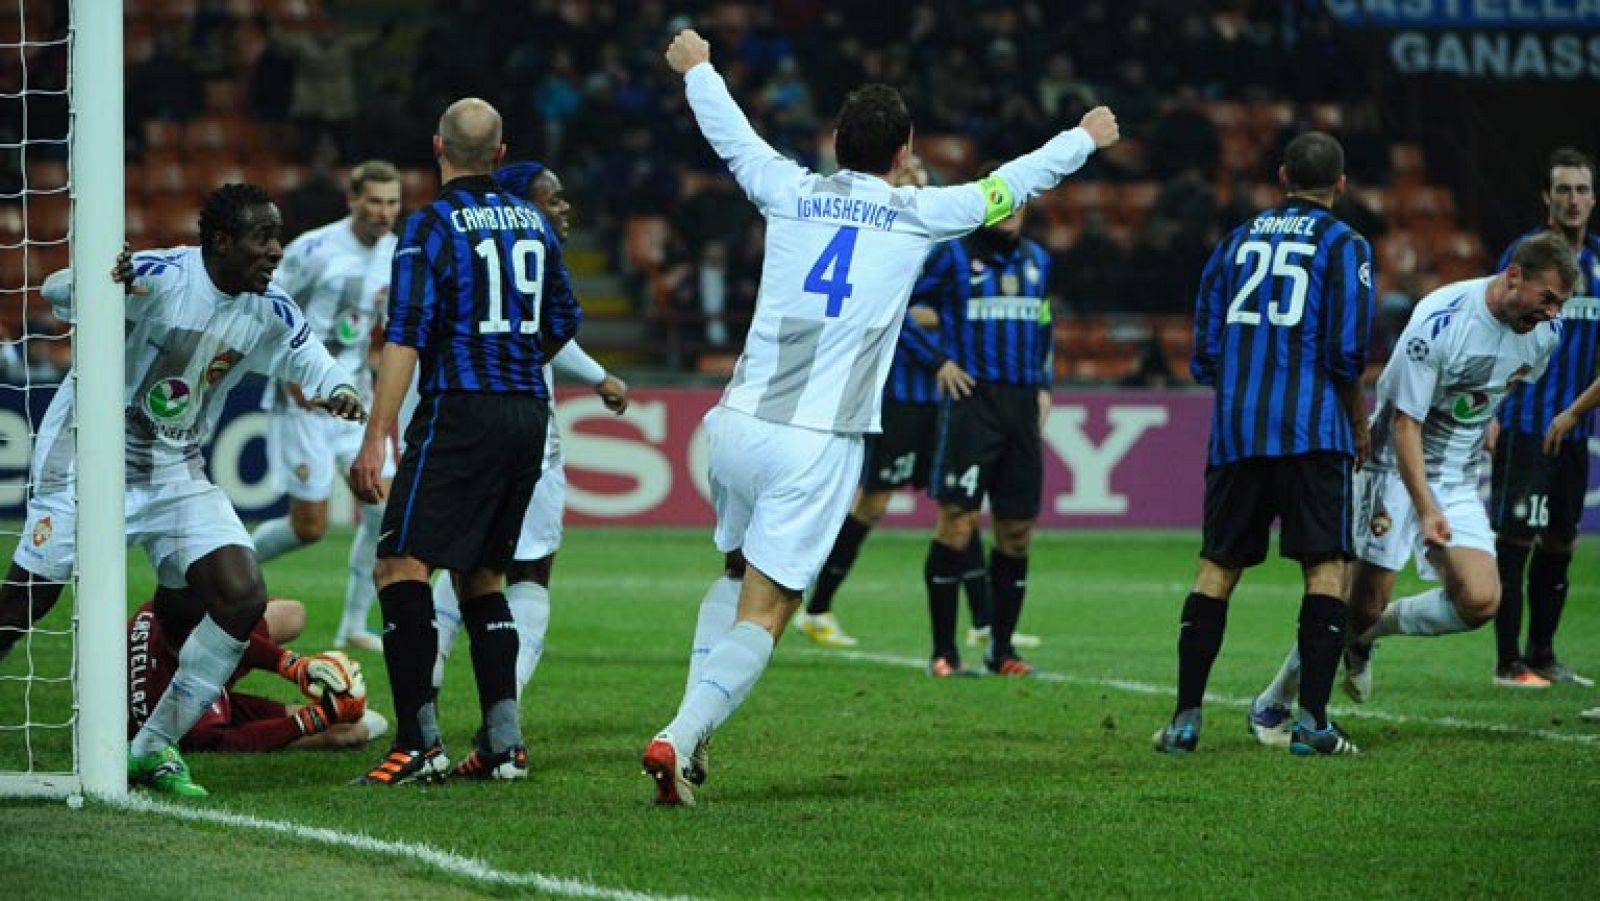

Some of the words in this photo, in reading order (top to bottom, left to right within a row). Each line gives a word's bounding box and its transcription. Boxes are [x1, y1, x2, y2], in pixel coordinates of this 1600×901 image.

[797, 196, 899, 232] IGNASHEVICH
[1249, 216, 1317, 236] SAMUEL
[475, 237, 546, 335] 19
[803, 226, 859, 318] 4
[1226, 242, 1317, 326] 25
[958, 464, 980, 497] 4
[1527, 494, 1550, 527] 16
[130, 610, 155, 727] CASTELLAZ
